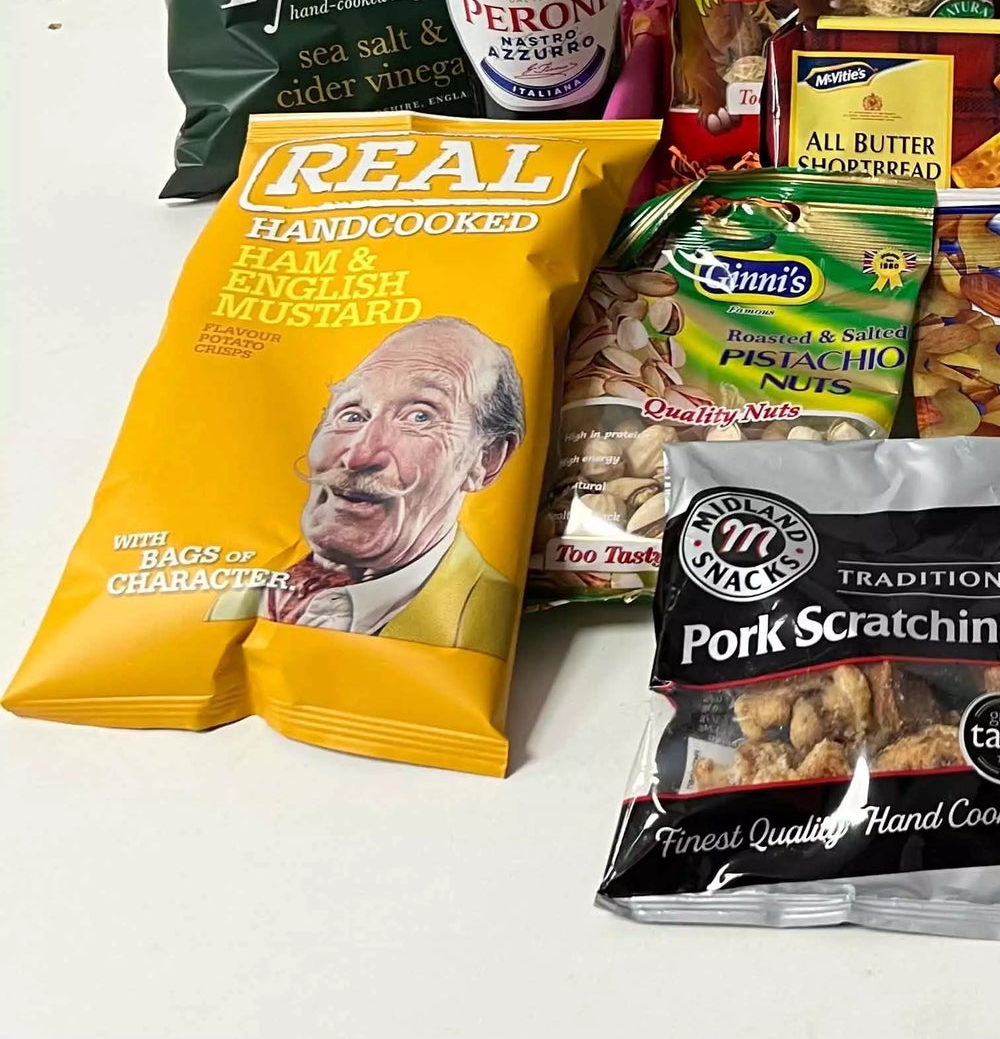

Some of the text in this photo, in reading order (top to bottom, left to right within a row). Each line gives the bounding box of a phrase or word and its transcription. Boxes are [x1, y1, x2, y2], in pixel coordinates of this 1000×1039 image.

[298, 18, 448, 70] sea salt &
[488, 35, 595, 61] AZZURRO
[501, 29, 576, 46] NASTRO
[276, 56, 466, 109] cider vinega
[512, 78, 583, 98] ITALIANA
[814, 68, 867, 88] McVitie's
[806, 131, 935, 155] ALL BUTTER
[263, 140, 555, 197] REAL
[244, 210, 540, 243] HANDCOOKED
[232, 244, 378, 272] HAM &
[221, 268, 410, 302] ENGLISH
[703, 262, 807, 295] Ginni's
[211, 293, 424, 328] MUSTARD
[727, 305, 775, 316] Famous
[198, 332, 265, 351] POTATO
[201, 322, 283, 344] FLAVOUR
[727, 325, 909, 345] Roasted & Salted
[193, 343, 253, 359] CRISPS
[719, 346, 906, 372] PISTACHIO
[760, 372, 853, 395] NUTS
[643, 398, 801, 427] Quality Nuts
[691, 496, 808, 544] MIDLAND
[113, 531, 169, 550] WITH
[139, 545, 256, 571] BAGS OF
[556, 544, 661, 567] Too Tasty
[106, 568, 296, 596] CHARACTER.
[691, 552, 801, 593] SNACKS
[680, 612, 787, 665] Pork
[655, 823, 743, 858] Finest
[748, 812, 851, 850] Quality
[863, 801, 944, 837] Hand
